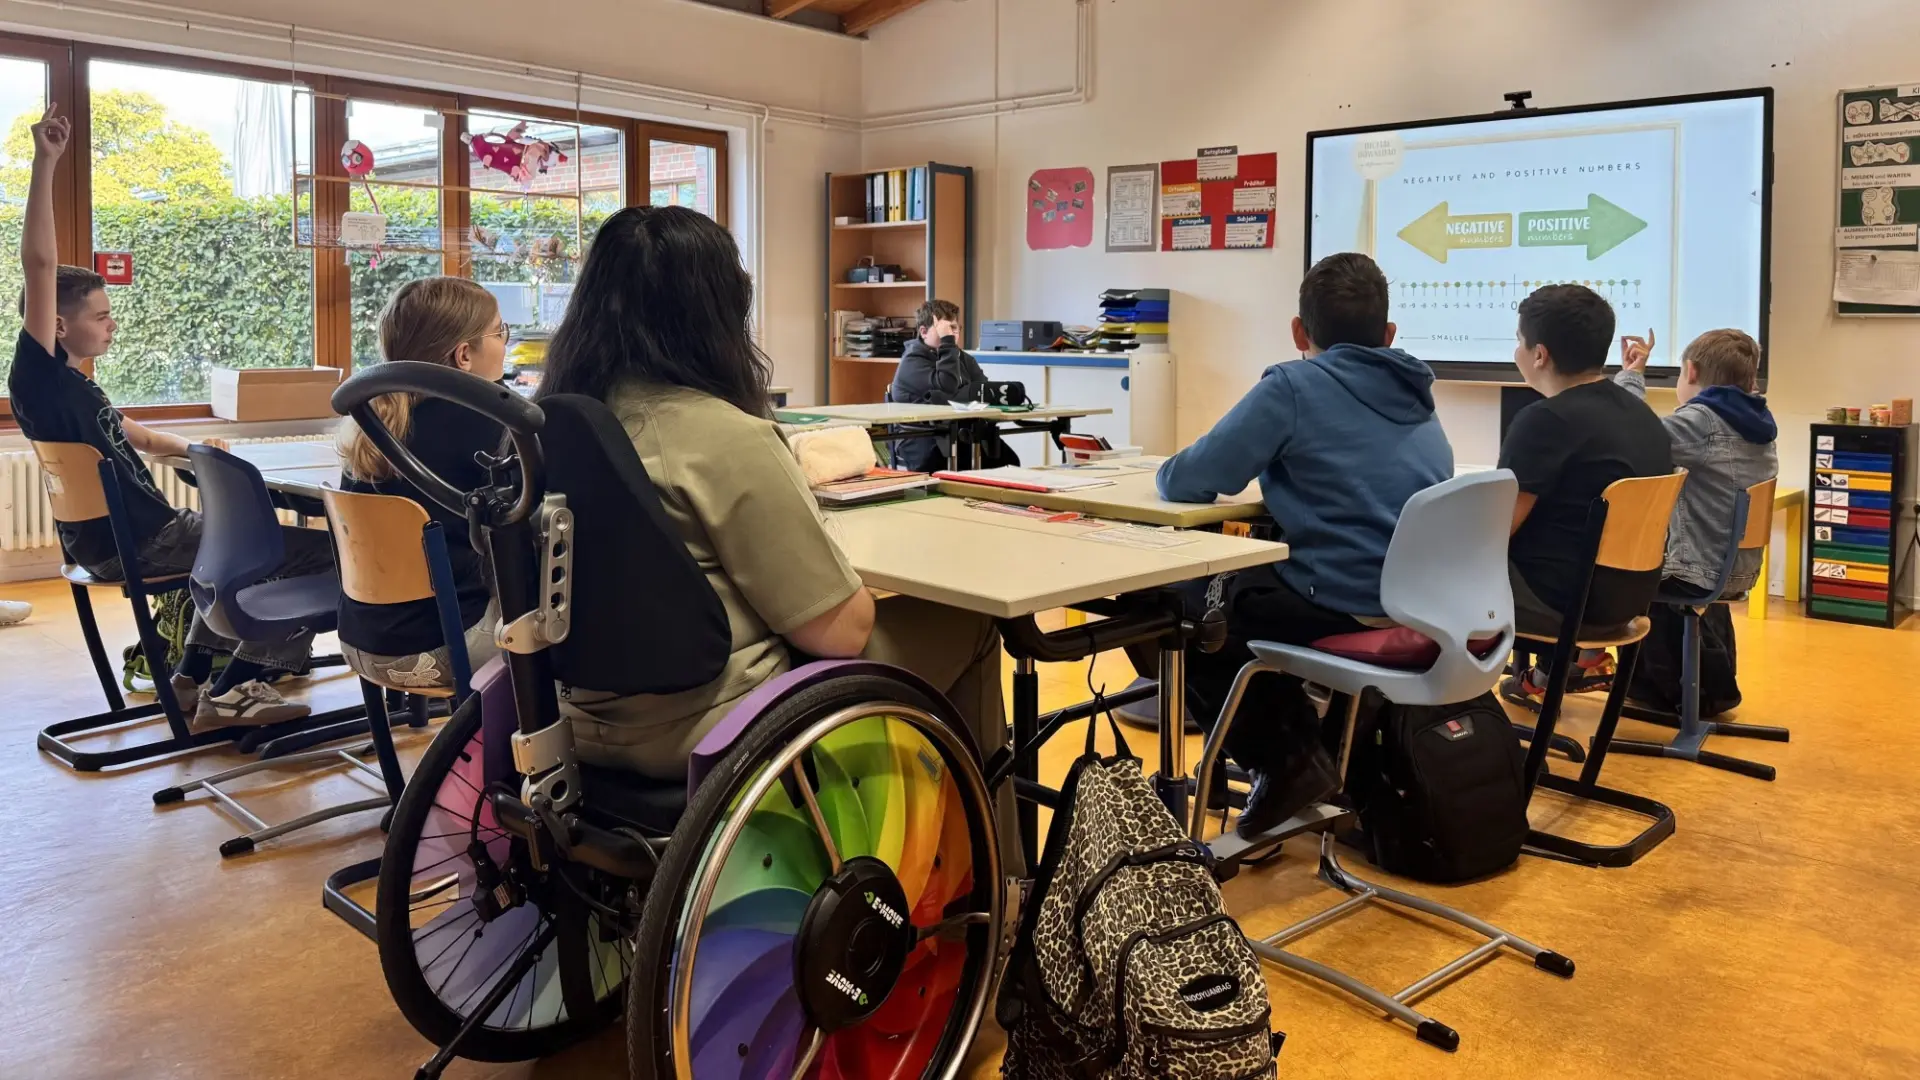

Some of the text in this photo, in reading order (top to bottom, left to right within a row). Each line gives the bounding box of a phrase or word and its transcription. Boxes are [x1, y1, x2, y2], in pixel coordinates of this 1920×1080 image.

[1403, 162, 1641, 184] NEGATIVE AND POSITIVE NUMBERS
[1236, 215, 1257, 223] Subjekt
[1528, 216, 1591, 232] POSITIVE
[1446, 220, 1505, 235] NEGATIVE
[1460, 235, 1504, 244] numbers
[1527, 231, 1573, 241] numbers
[1510, 300, 1518, 311] 0
